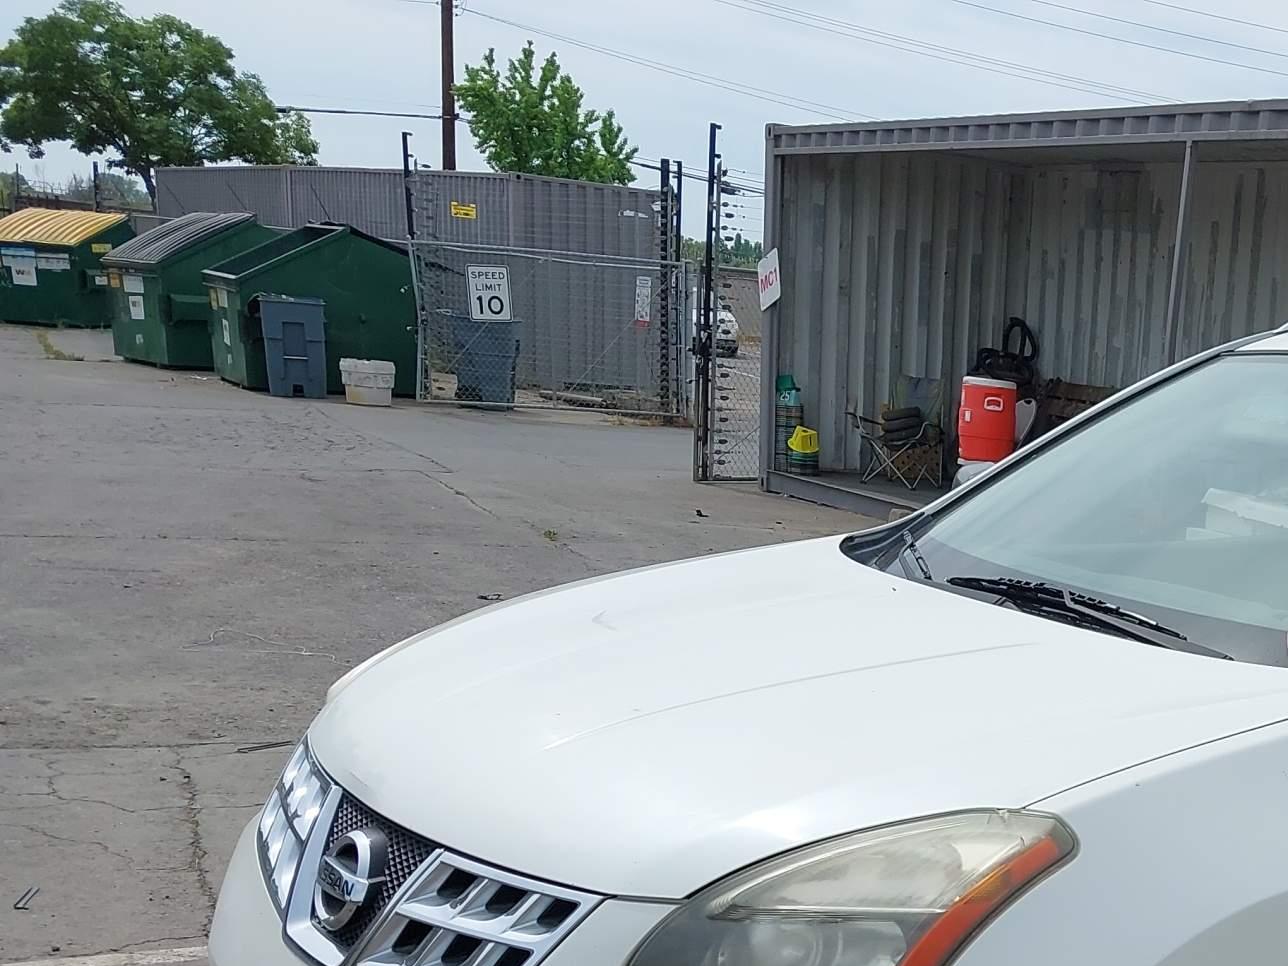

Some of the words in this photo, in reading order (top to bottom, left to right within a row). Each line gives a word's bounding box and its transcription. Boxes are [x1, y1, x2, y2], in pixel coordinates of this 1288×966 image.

[470, 271, 506, 280] SPEED
[761, 266, 778, 294] MC1
[475, 283, 502, 292] LIMIT
[476, 295, 505, 315] 10
